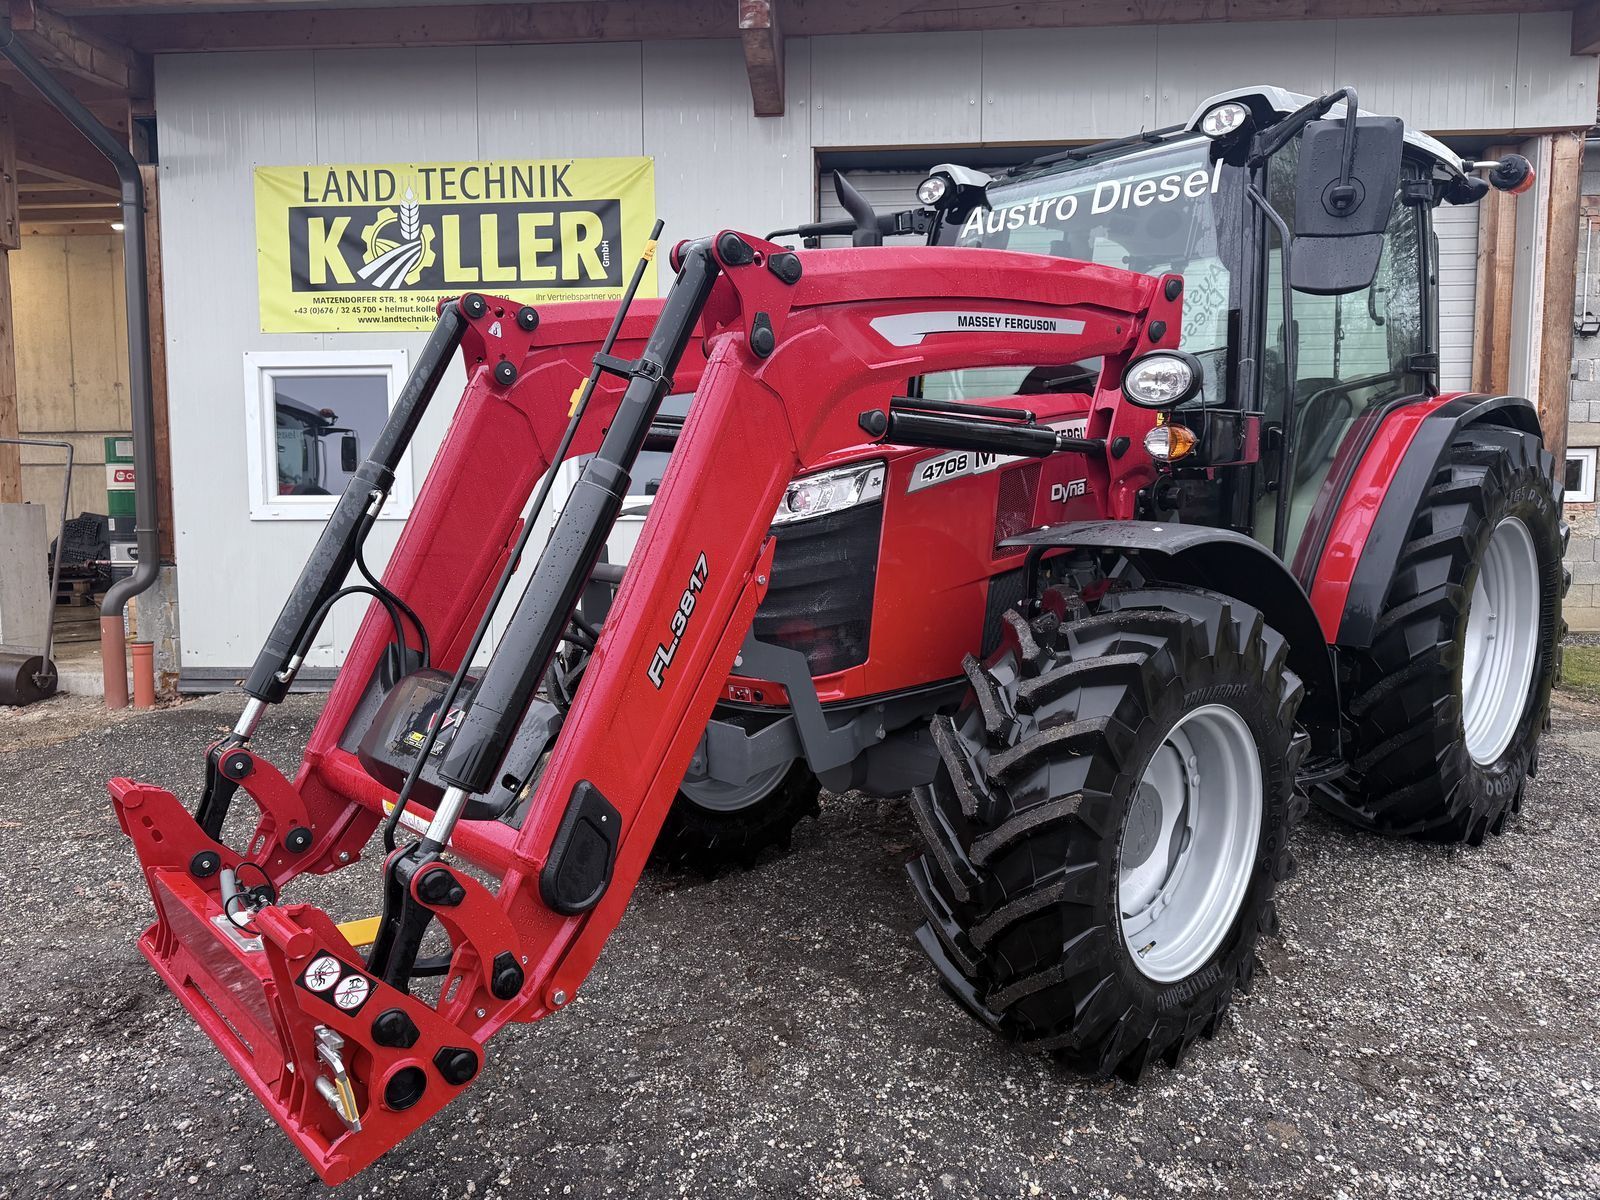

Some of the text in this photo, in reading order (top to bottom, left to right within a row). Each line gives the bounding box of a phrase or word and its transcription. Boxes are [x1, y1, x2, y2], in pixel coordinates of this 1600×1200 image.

[303, 164, 573, 203] LAND TECHNIK
[960, 158, 1224, 239] Austro Diesel
[602, 240, 610, 267] GmbH
[312, 296, 377, 304] MATZENDORFER
[548, 293, 606, 302] Vertriebspartner
[309, 307, 334, 315] (0)676
[957, 315, 1057, 331] MASSEY FERGUSON
[921, 455, 968, 483] 4708
[1051, 478, 1087, 504] Dyna
[646, 550, 709, 691] FL.3817
